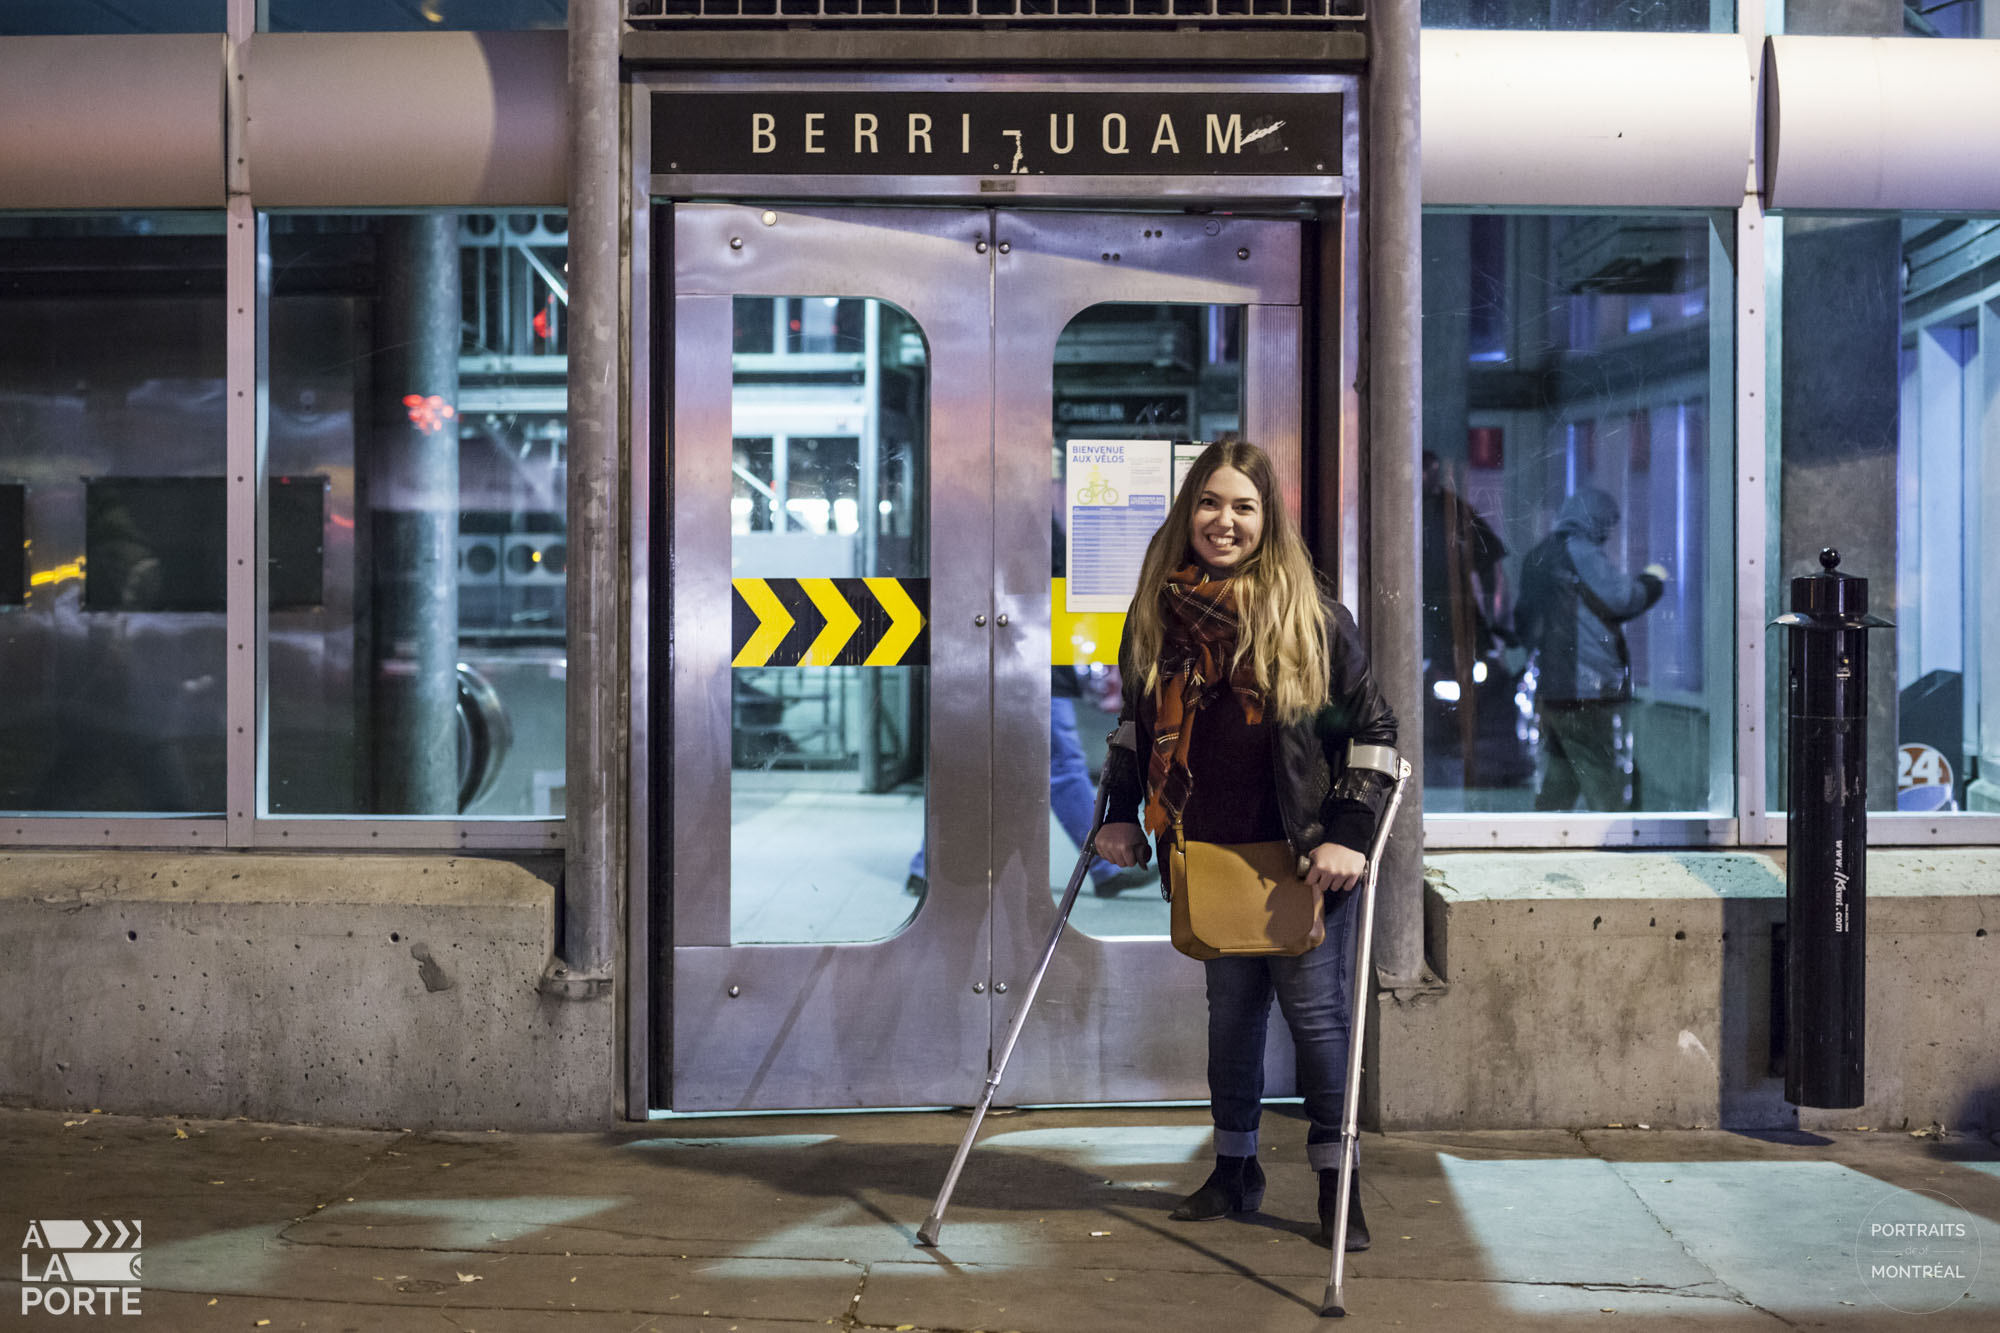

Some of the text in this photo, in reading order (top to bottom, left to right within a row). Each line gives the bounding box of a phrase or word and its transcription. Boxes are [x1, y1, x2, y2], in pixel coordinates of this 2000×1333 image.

[1072, 445, 1125, 454] BIENVENUE
[1072, 455, 1091, 463] AUX
[1095, 453, 1125, 463] VÉLOS
